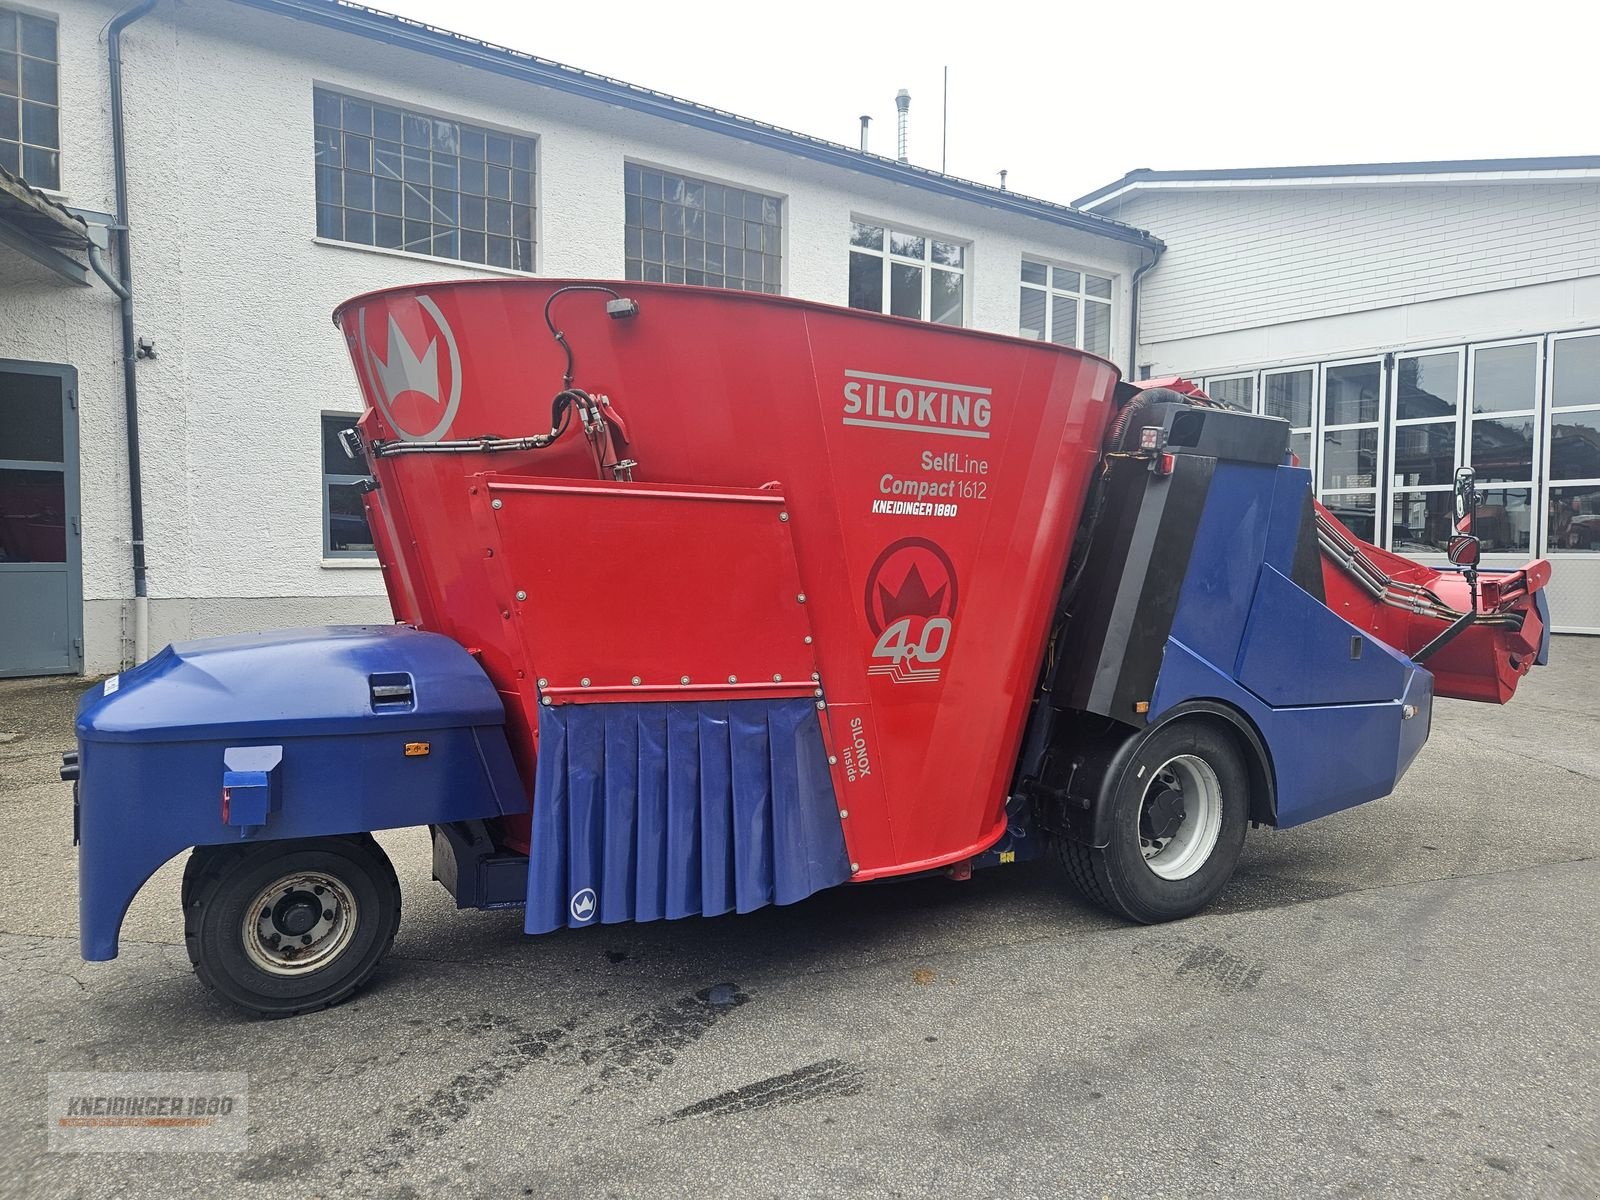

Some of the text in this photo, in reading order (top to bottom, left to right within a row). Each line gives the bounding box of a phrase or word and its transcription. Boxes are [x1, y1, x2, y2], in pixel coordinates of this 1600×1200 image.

[843, 381, 991, 428] SILOKING
[921, 451, 989, 475] SelfLine
[880, 474, 987, 500] Compact 1612
[871, 499, 958, 517] KNEIDINGER 1880
[850, 716, 872, 778] SILONOX
[842, 746, 856, 783] inside
